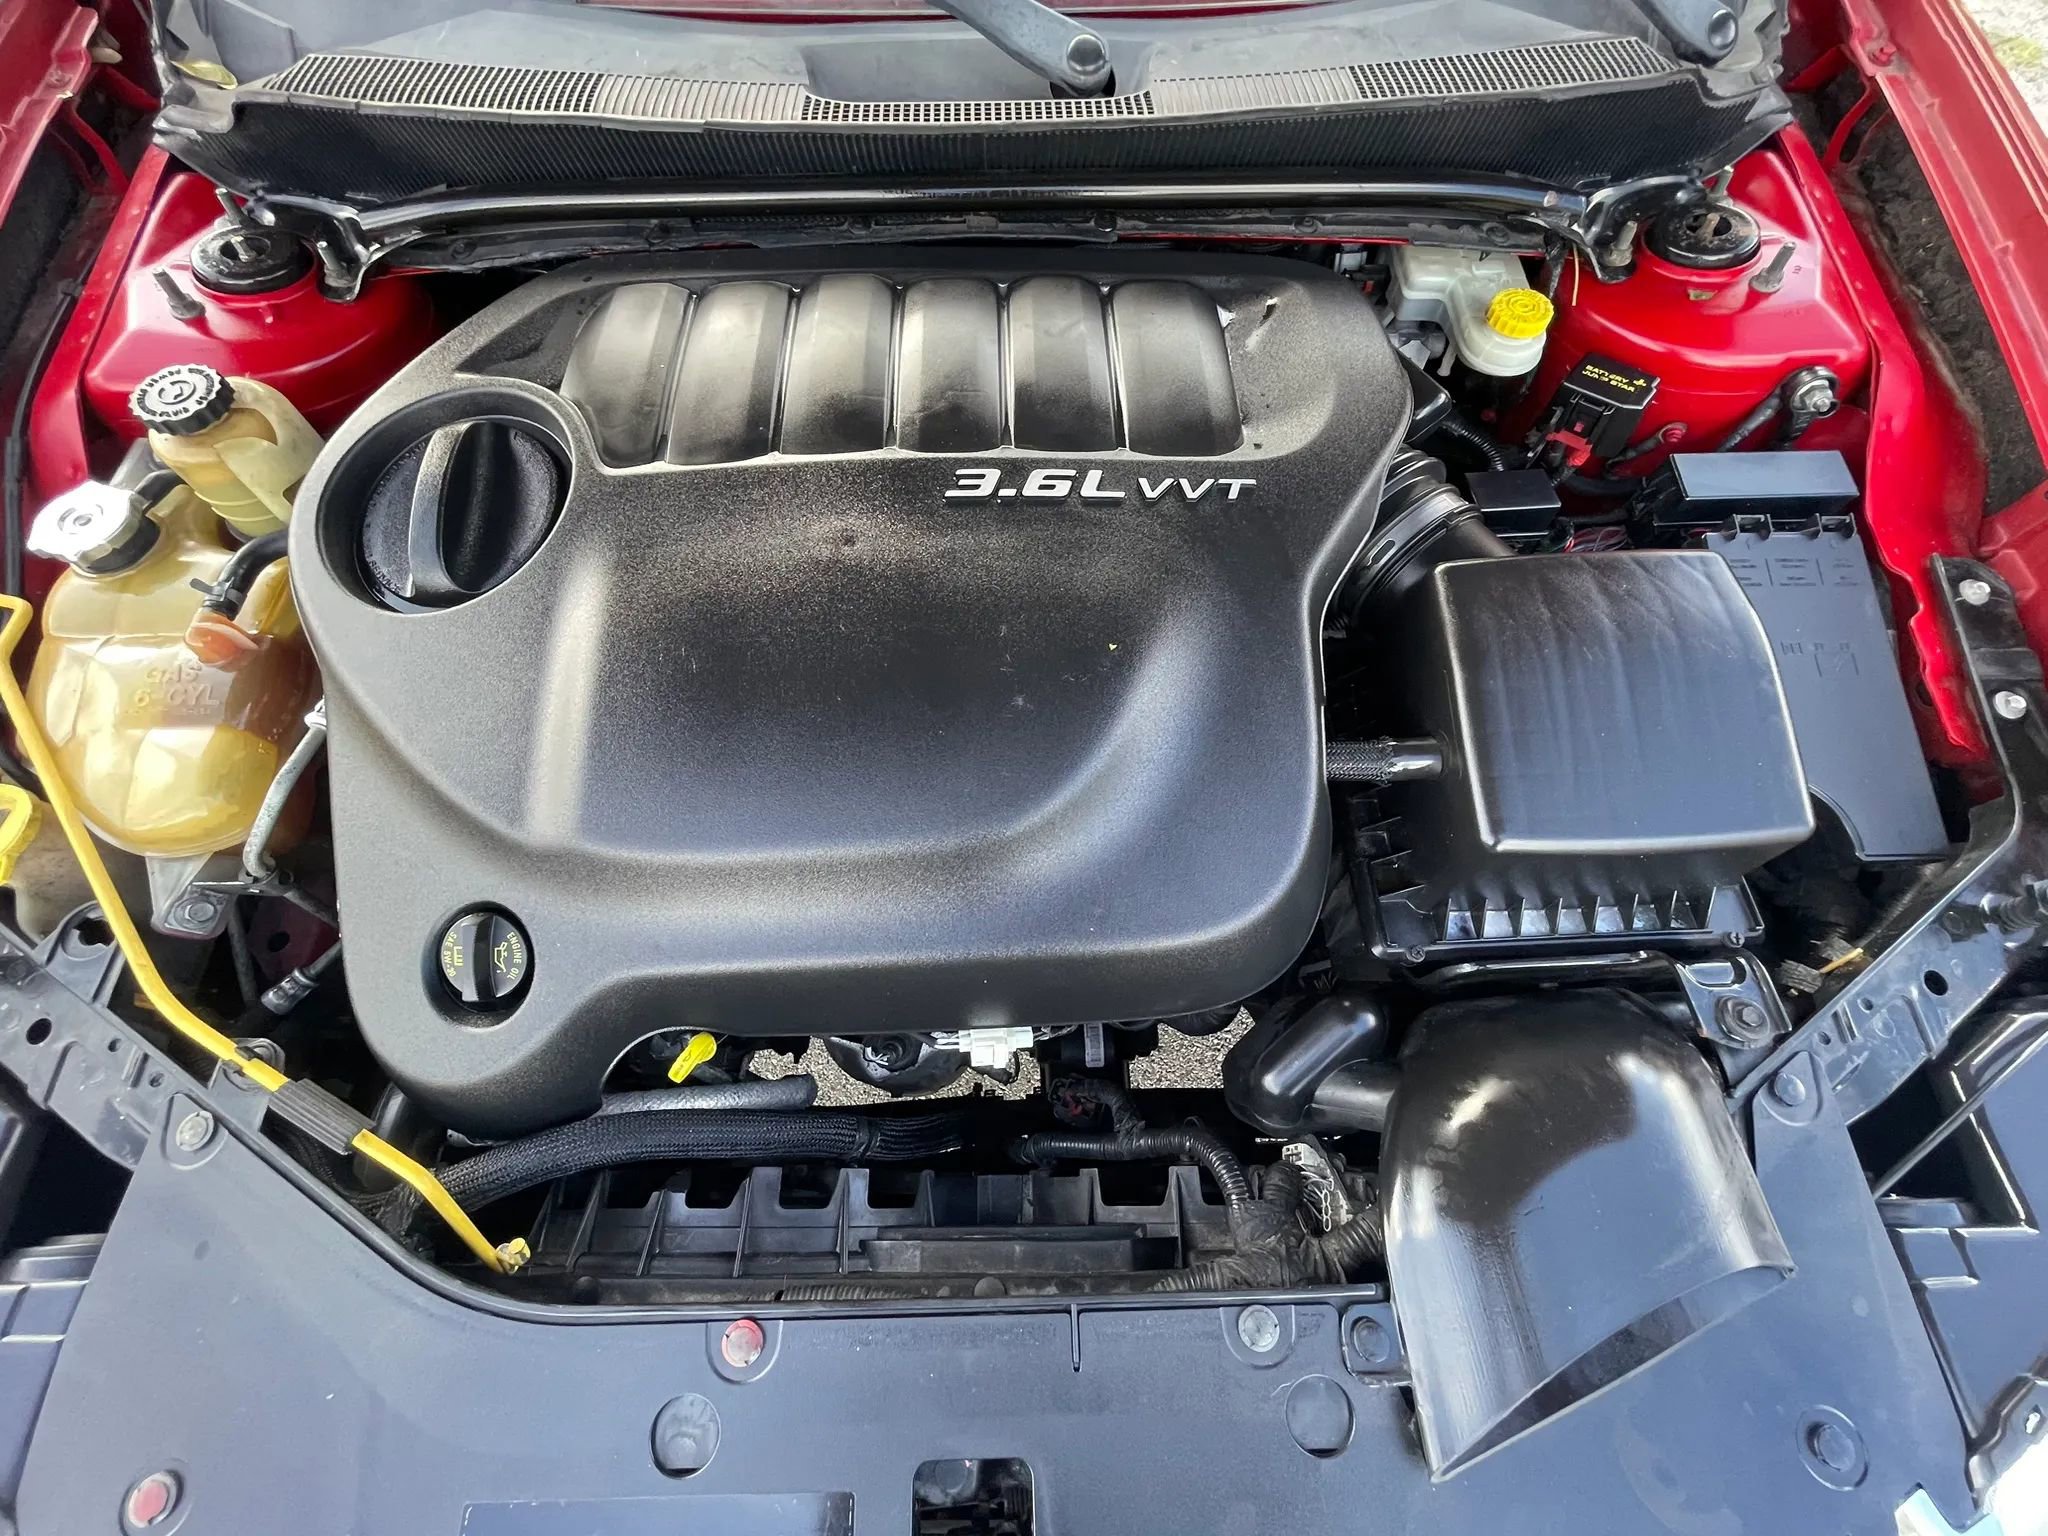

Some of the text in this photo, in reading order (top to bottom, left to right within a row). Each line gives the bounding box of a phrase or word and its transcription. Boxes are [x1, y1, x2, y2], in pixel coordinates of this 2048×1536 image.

[944, 468, 1257, 501] 3.6L VVT
[445, 931, 457, 948] SAE
[506, 931, 522, 980] ENGINE OIL
